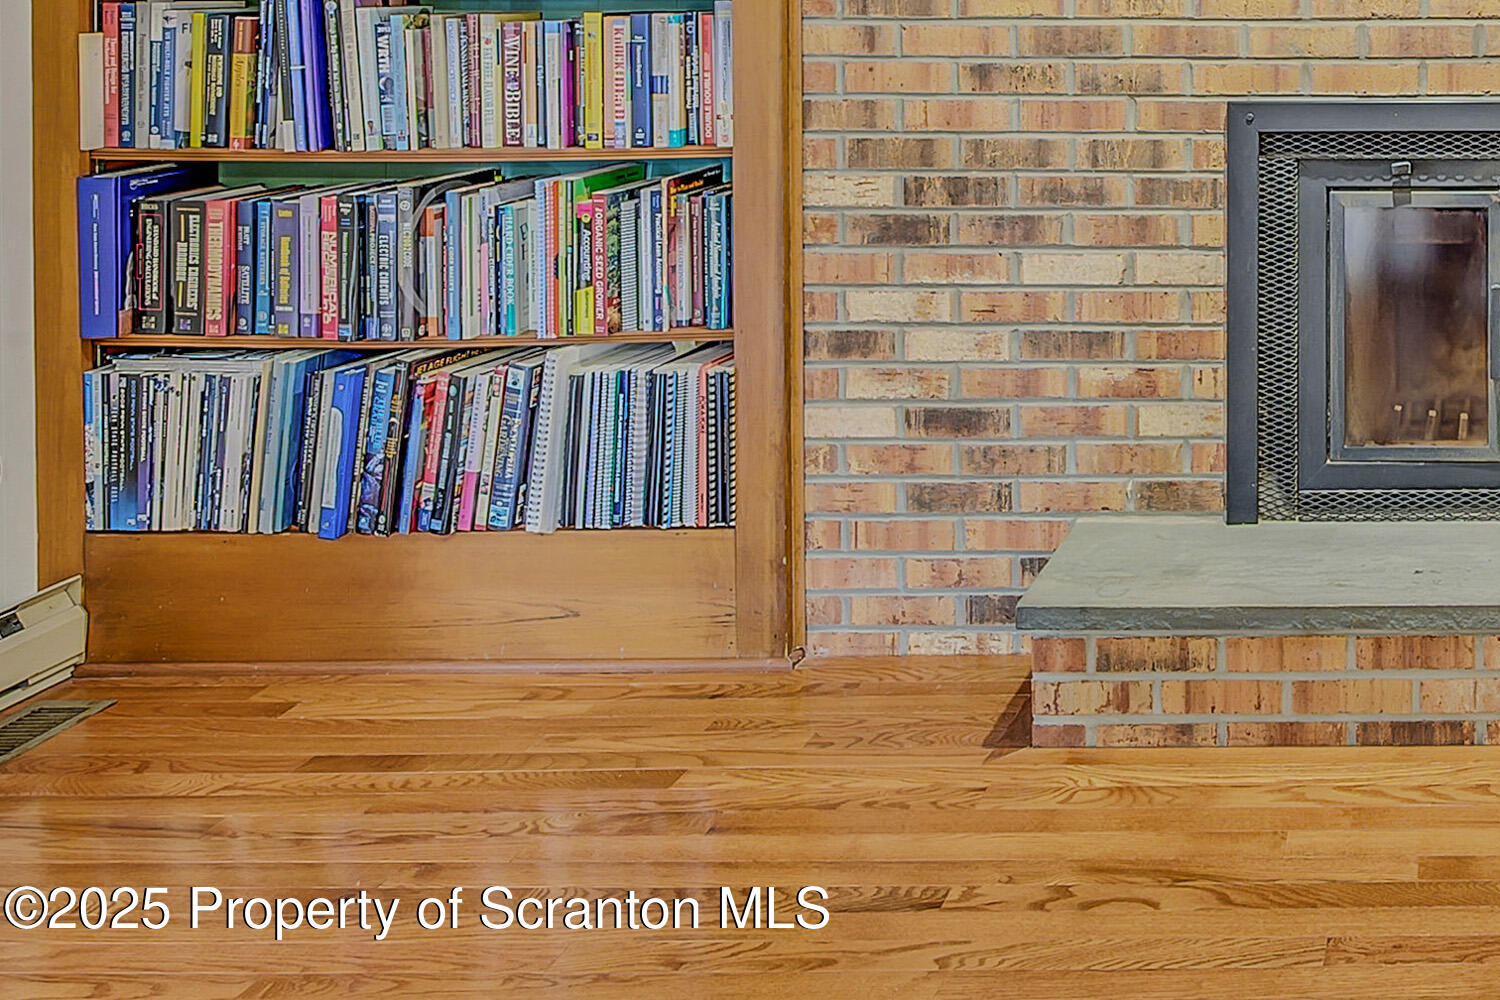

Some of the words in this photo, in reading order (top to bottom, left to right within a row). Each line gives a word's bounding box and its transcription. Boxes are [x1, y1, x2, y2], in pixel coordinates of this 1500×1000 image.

[377, 35, 390, 74] WRTH
[504, 35, 521, 77] WINE
[163, 76, 171, 102] FIGHTER
[703, 72, 712, 105] DOUBLE
[163, 102, 171, 117] JETS
[504, 88, 521, 139] BIBLE
[704, 105, 713, 138] DOUBLE
[144, 218, 152, 260] ENGINEERING
[188, 214, 200, 265] ELECTRONICS
[504, 215, 513, 244] HARD
[595, 212, 604, 253] ORGANIC
[654, 212, 663, 240] Practical
[176, 241, 187, 282] HANDBOOK
[279, 236, 291, 267] Handbook
[378, 234, 389, 270] ELECTRIC
[505, 246, 514, 275] CIDER
[582, 229, 592, 282] Accounting
[595, 255, 604, 279] SEED
[654, 241, 663, 258] Lean
[144, 260, 152, 306] CALCULATIONS
[206, 222, 223, 321] THERMODYNAMICS
[241, 265, 251, 304] SATELLITE
[329, 231, 337, 320] NUMERICAL
[378, 271, 390, 305] CIRCUITS
[654, 258, 663, 295] Accounting
[279, 276, 291, 304] Batteries
[505, 277, 515, 305] BOOK
[595, 280, 604, 320] GROWER
[427, 356, 445, 372] AGE
[494, 414, 511, 478] GARDENING
